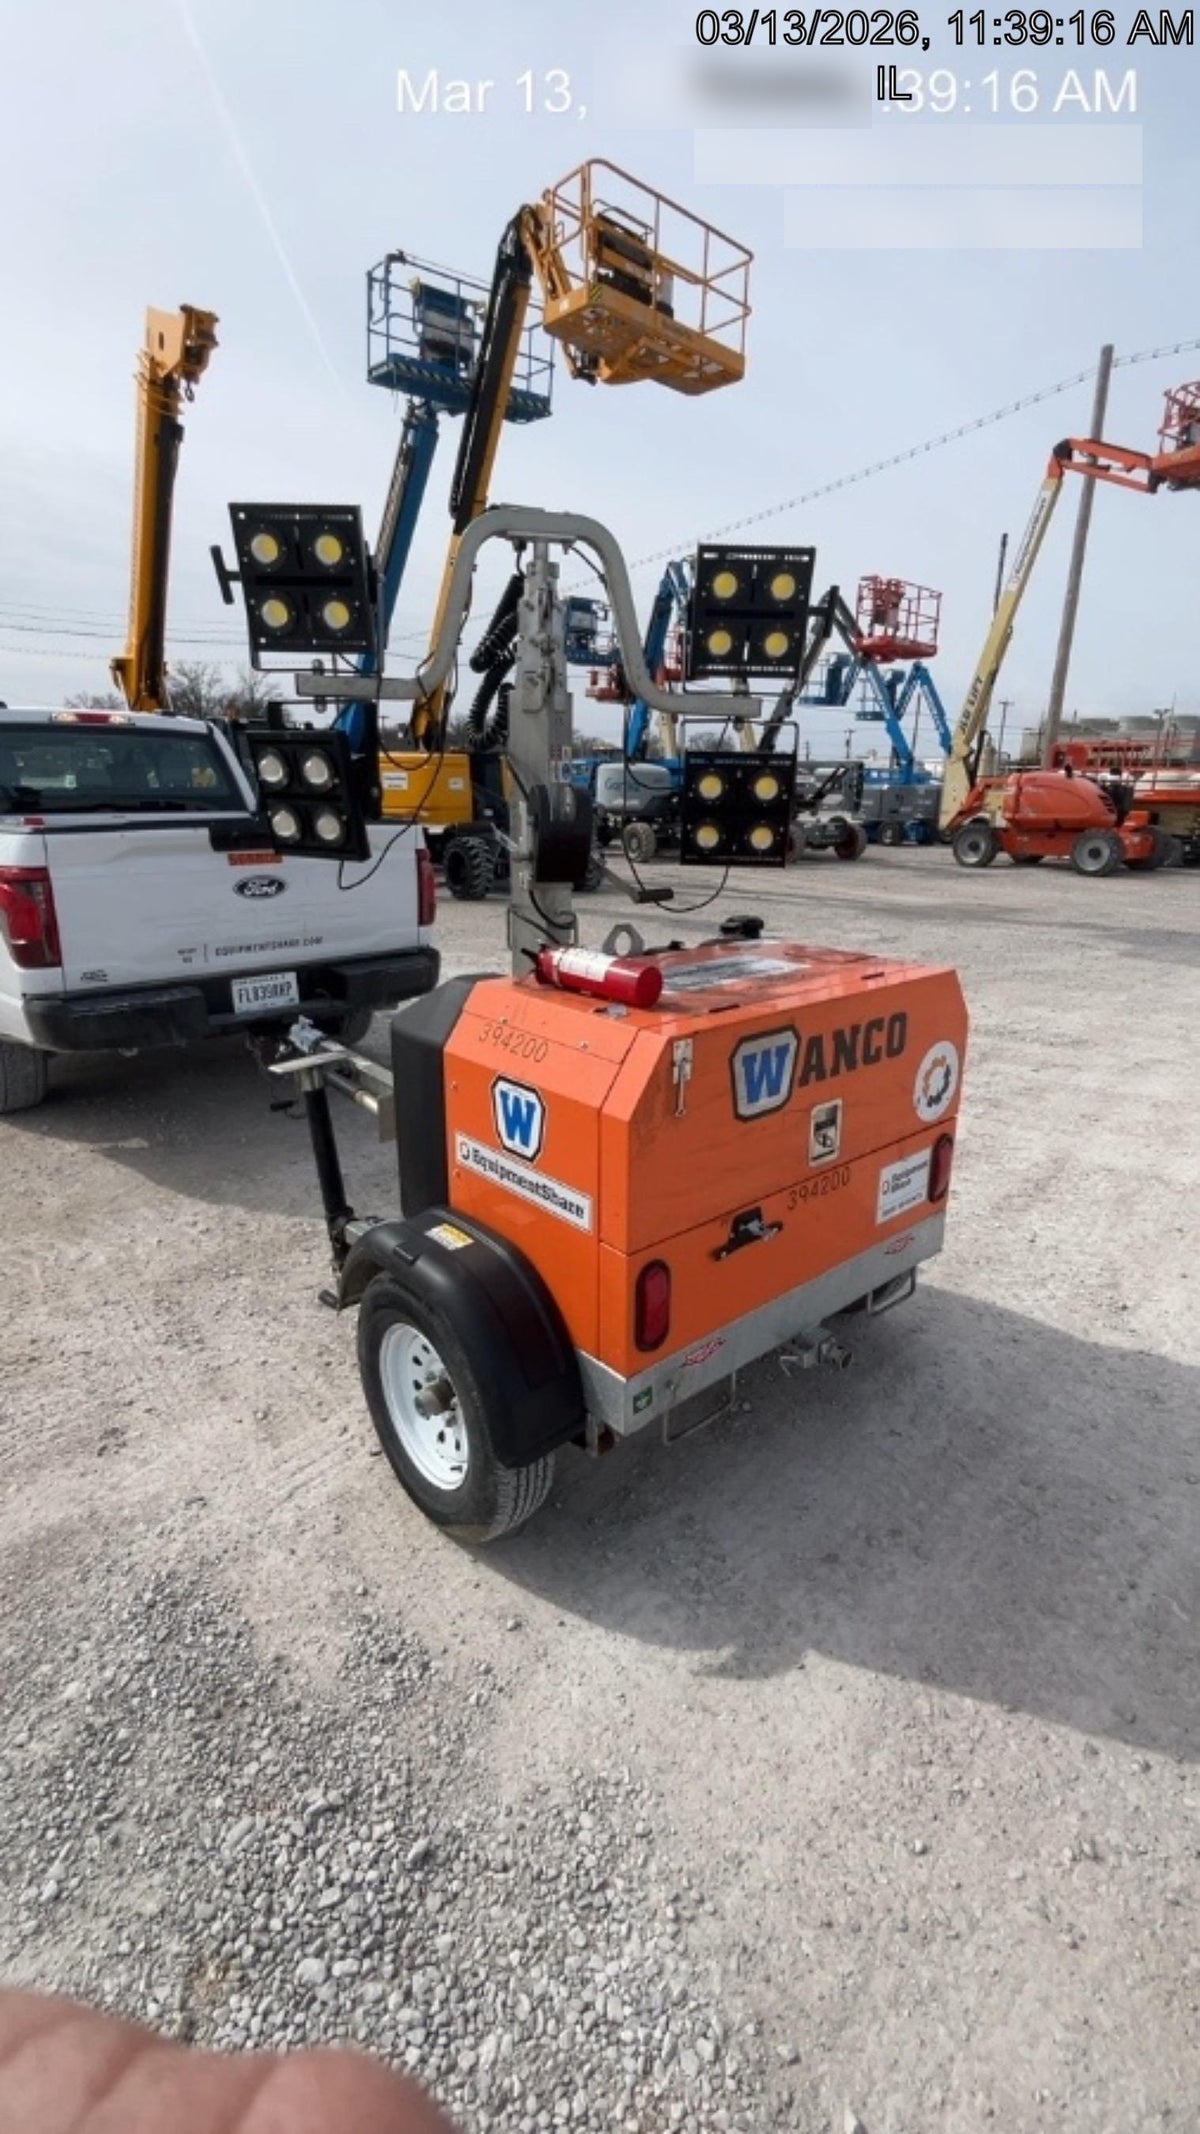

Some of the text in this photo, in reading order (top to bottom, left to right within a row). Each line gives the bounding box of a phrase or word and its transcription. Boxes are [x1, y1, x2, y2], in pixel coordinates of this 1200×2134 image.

[478, 1021, 549, 1063] 394200
[738, 1010, 908, 1106] WANCO
[499, 1089, 537, 1149] W
[471, 1146, 585, 1220] EquipmentShare
[786, 1166, 851, 1211] 394200
